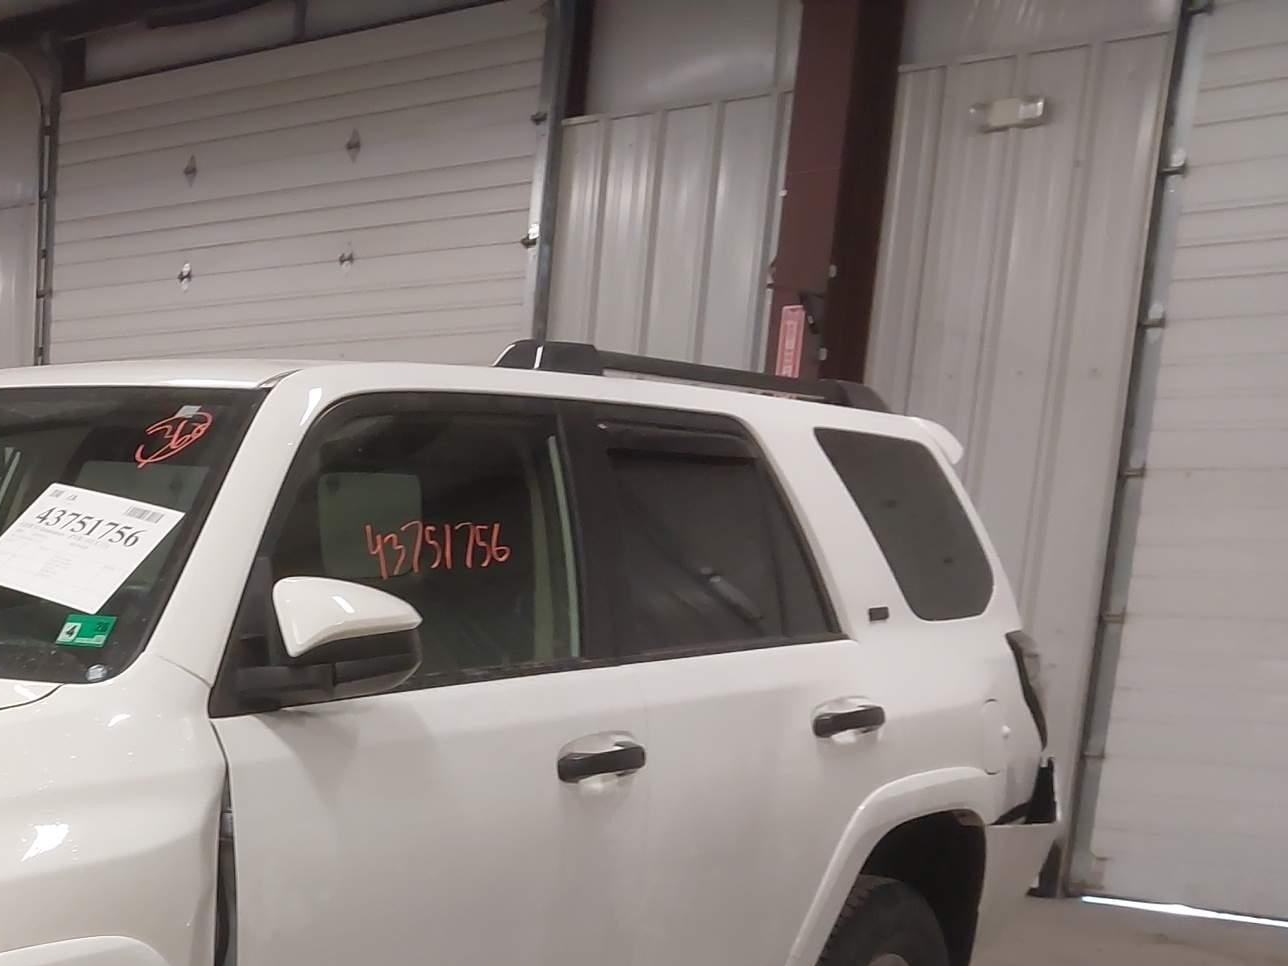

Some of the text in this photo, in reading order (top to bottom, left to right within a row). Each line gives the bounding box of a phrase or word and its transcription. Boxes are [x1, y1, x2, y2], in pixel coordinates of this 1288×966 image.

[36, 506, 148, 548] 43751756
[364, 520, 511, 579] 43751756
[65, 624, 78, 637] 4
